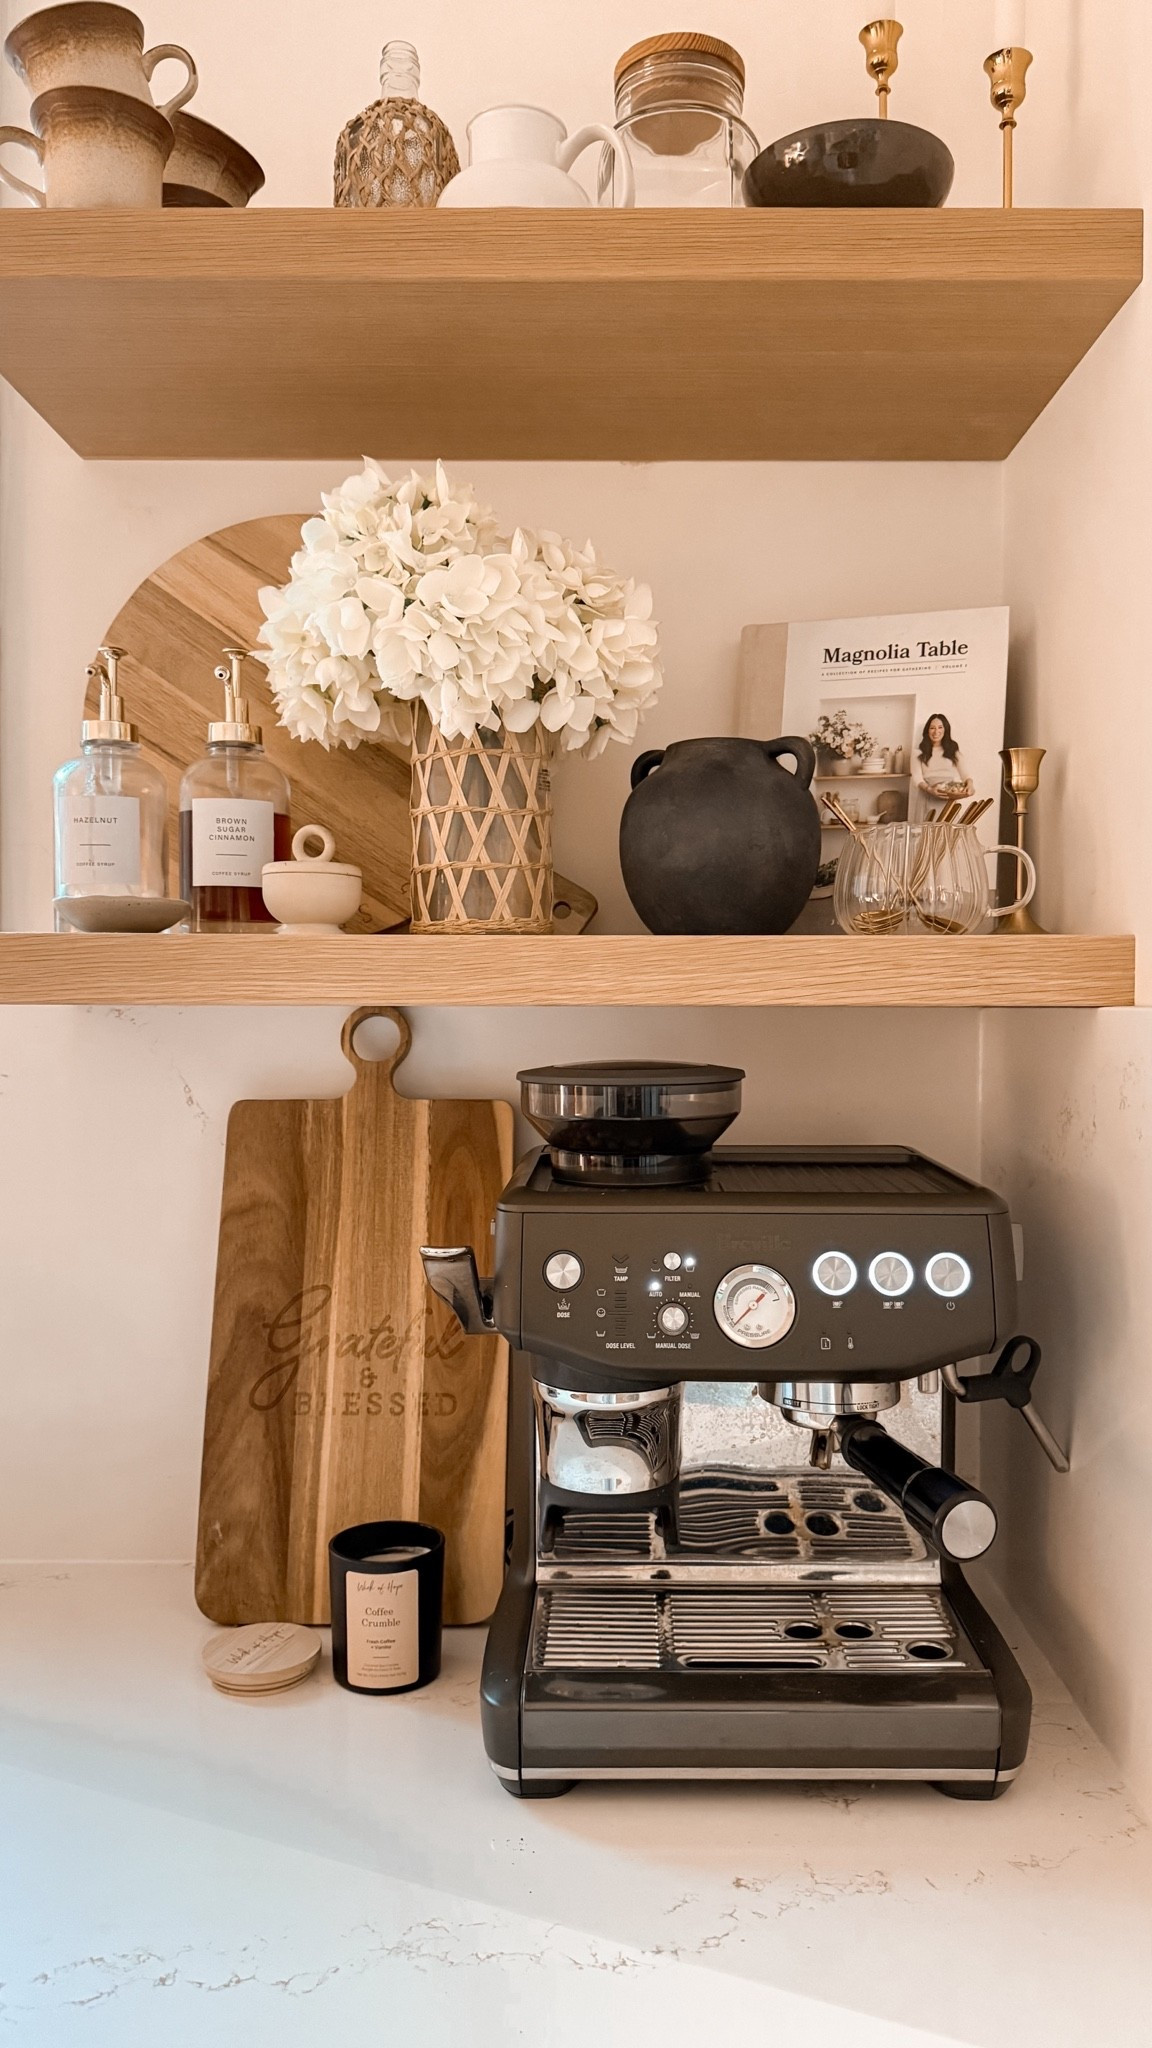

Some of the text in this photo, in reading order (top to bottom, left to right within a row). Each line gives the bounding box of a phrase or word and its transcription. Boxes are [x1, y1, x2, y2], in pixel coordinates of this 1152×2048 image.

[822, 639, 969, 666] Magnolia Table
[73, 816, 118, 824] HAZELNUT
[215, 817, 248, 825] BROWN
[208, 834, 256, 842] CINNAMON
[250, 1284, 465, 1411] Grateful
[359, 1366, 378, 1389] &
[293, 1391, 458, 1417] BLESSED
[365, 1607, 395, 1616] Coffee
[361, 1618, 402, 1628] Crumble
